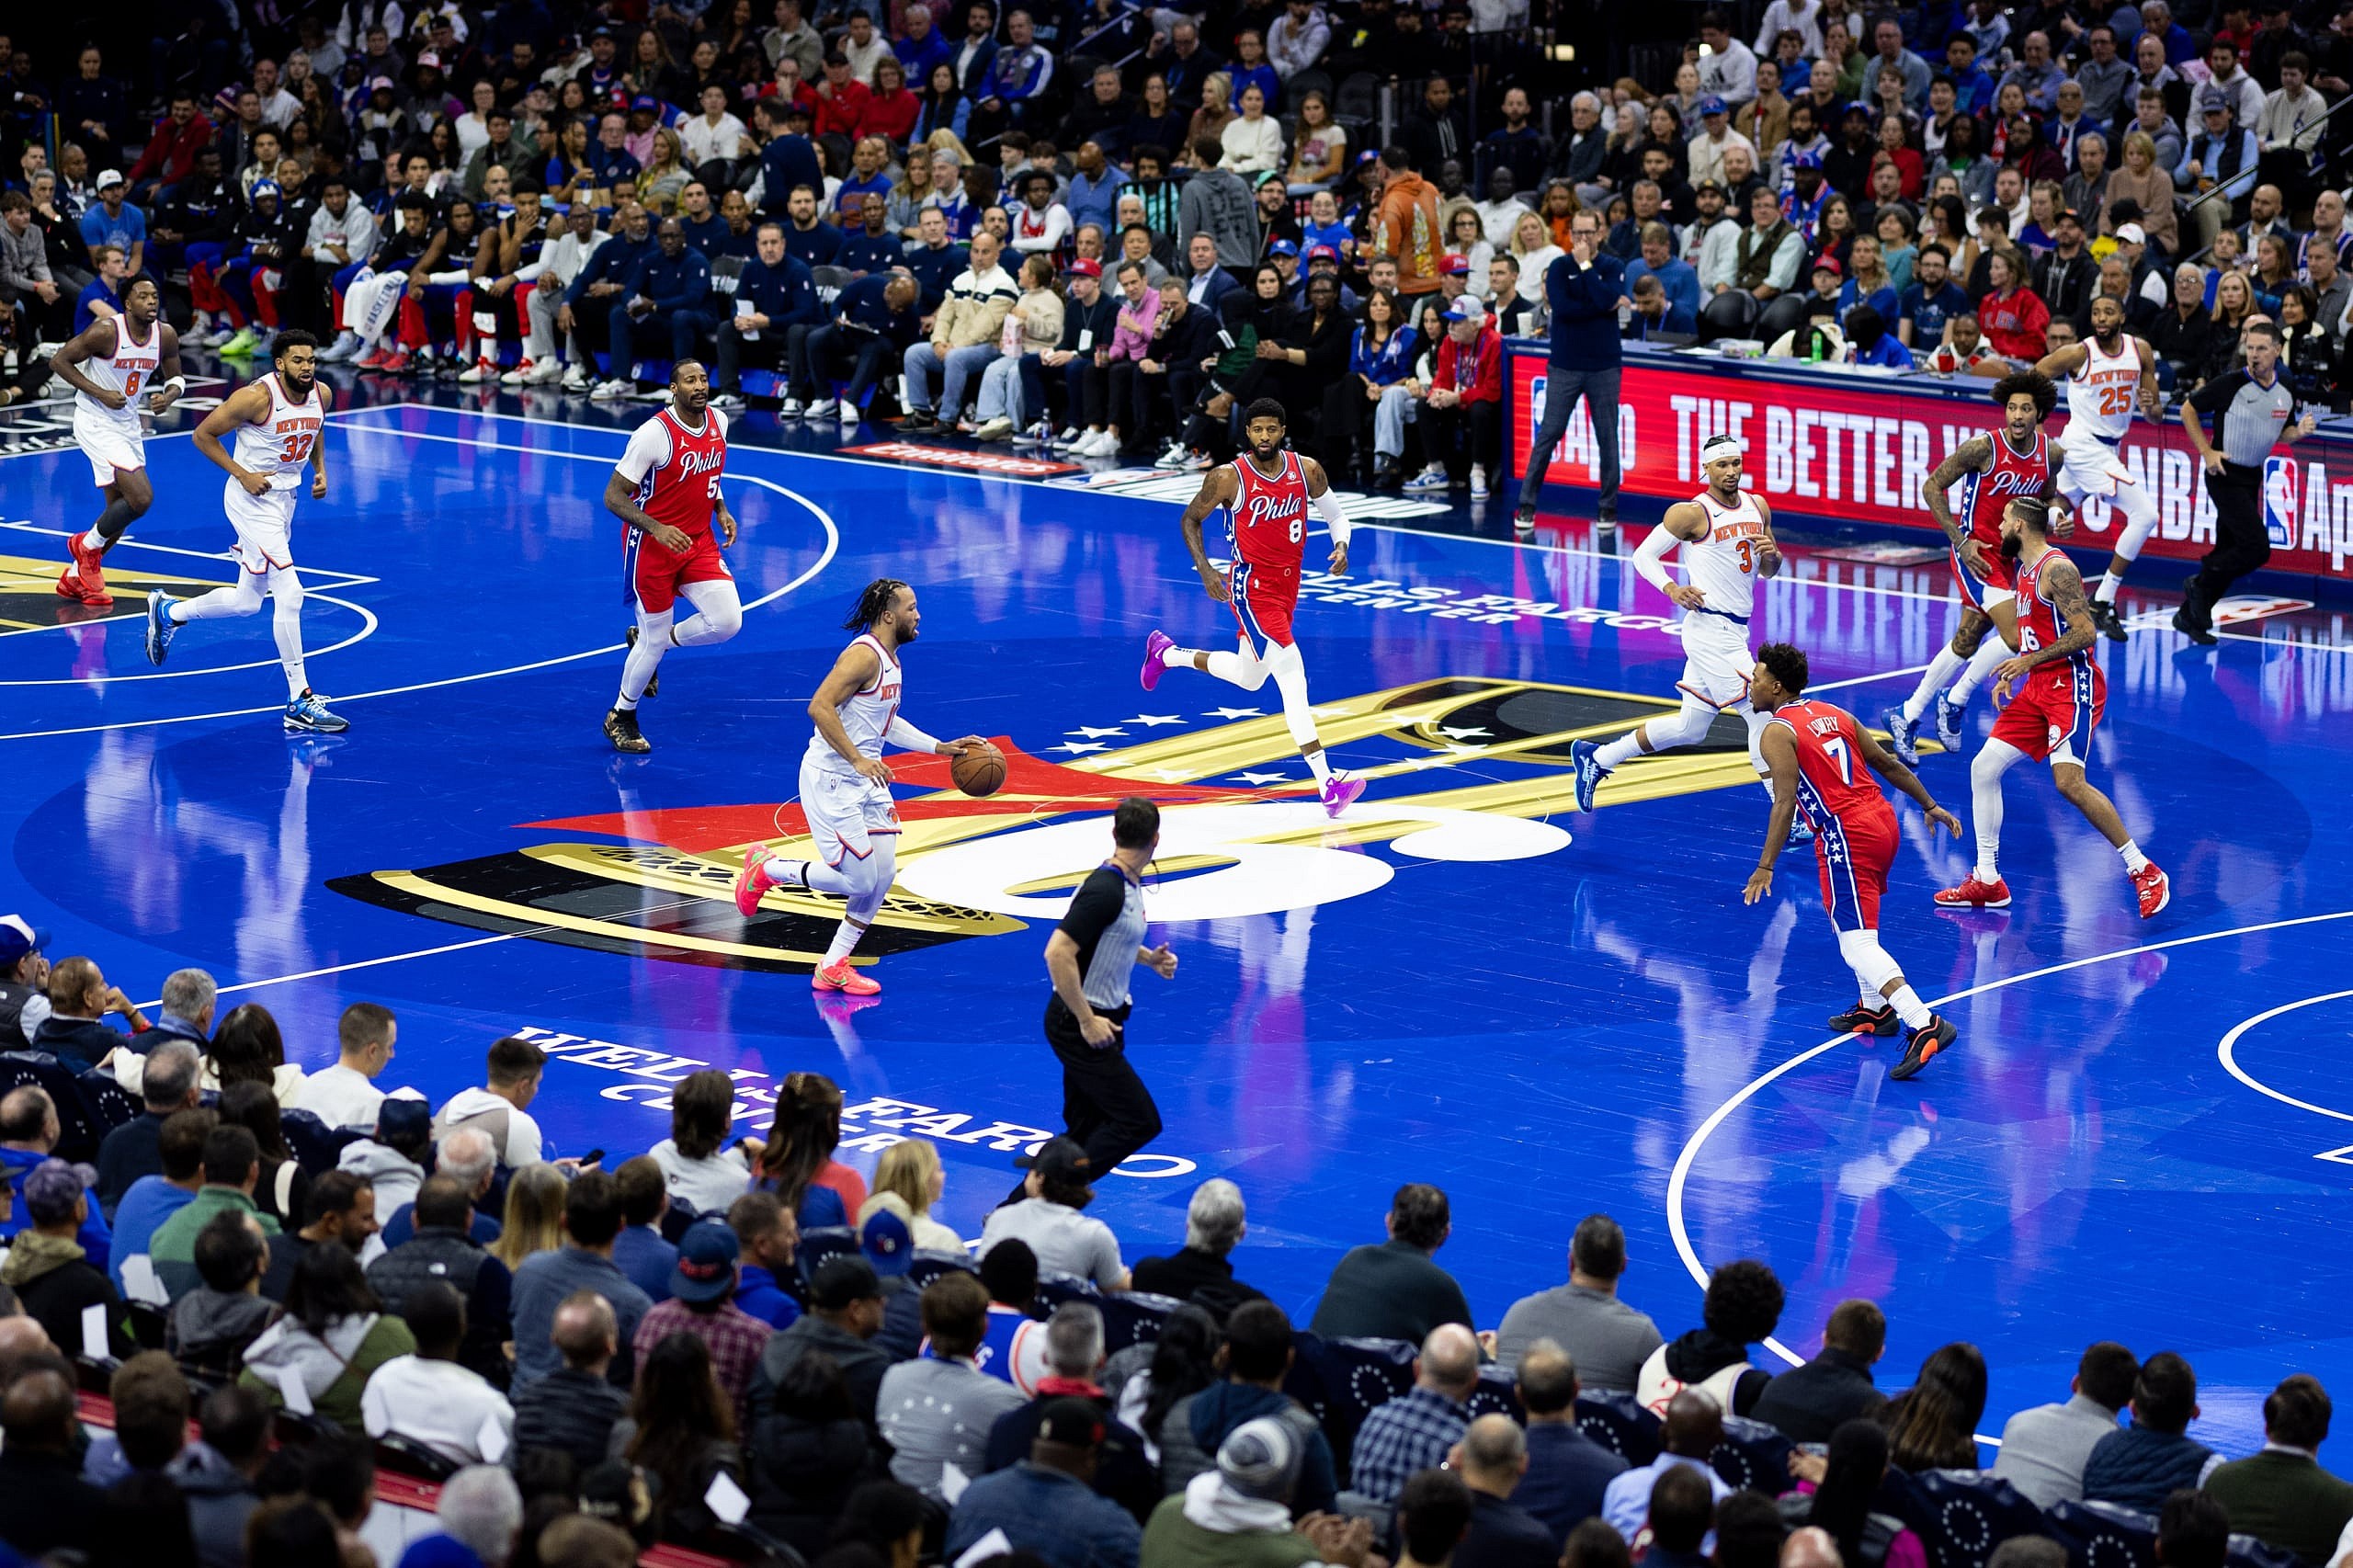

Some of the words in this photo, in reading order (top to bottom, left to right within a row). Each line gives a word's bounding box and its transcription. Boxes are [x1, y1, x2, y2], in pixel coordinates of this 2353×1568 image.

[114, 358, 136, 369] NEW
[136, 358, 157, 370] YORK
[125, 371, 141, 397] 8
[2090, 370, 2113, 386] NEW
[2111, 369, 2141, 381] YORK
[2099, 386, 2132, 415] 25
[276, 417, 299, 435] NEW
[298, 417, 321, 434] YORK
[280, 434, 313, 462] 32
[1670, 394, 1753, 490] THE
[1766, 404, 1929, 512] BETTER
[678, 447, 722, 483] Phila
[707, 474, 720, 499] 5
[1988, 471, 2044, 496] Phila
[2127, 445, 2217, 545] NBA
[1248, 493, 1302, 528] Phila
[1289, 518, 1303, 544] 8
[1714, 525, 1738, 543] NEW
[1737, 521, 1763, 539] YORK
[1736, 540, 1753, 574] 3
[2016, 590, 2032, 618] hila
[2020, 626, 2040, 651] 16
[1807, 717, 1838, 738] LOWRY
[1822, 736, 1853, 787] 7
